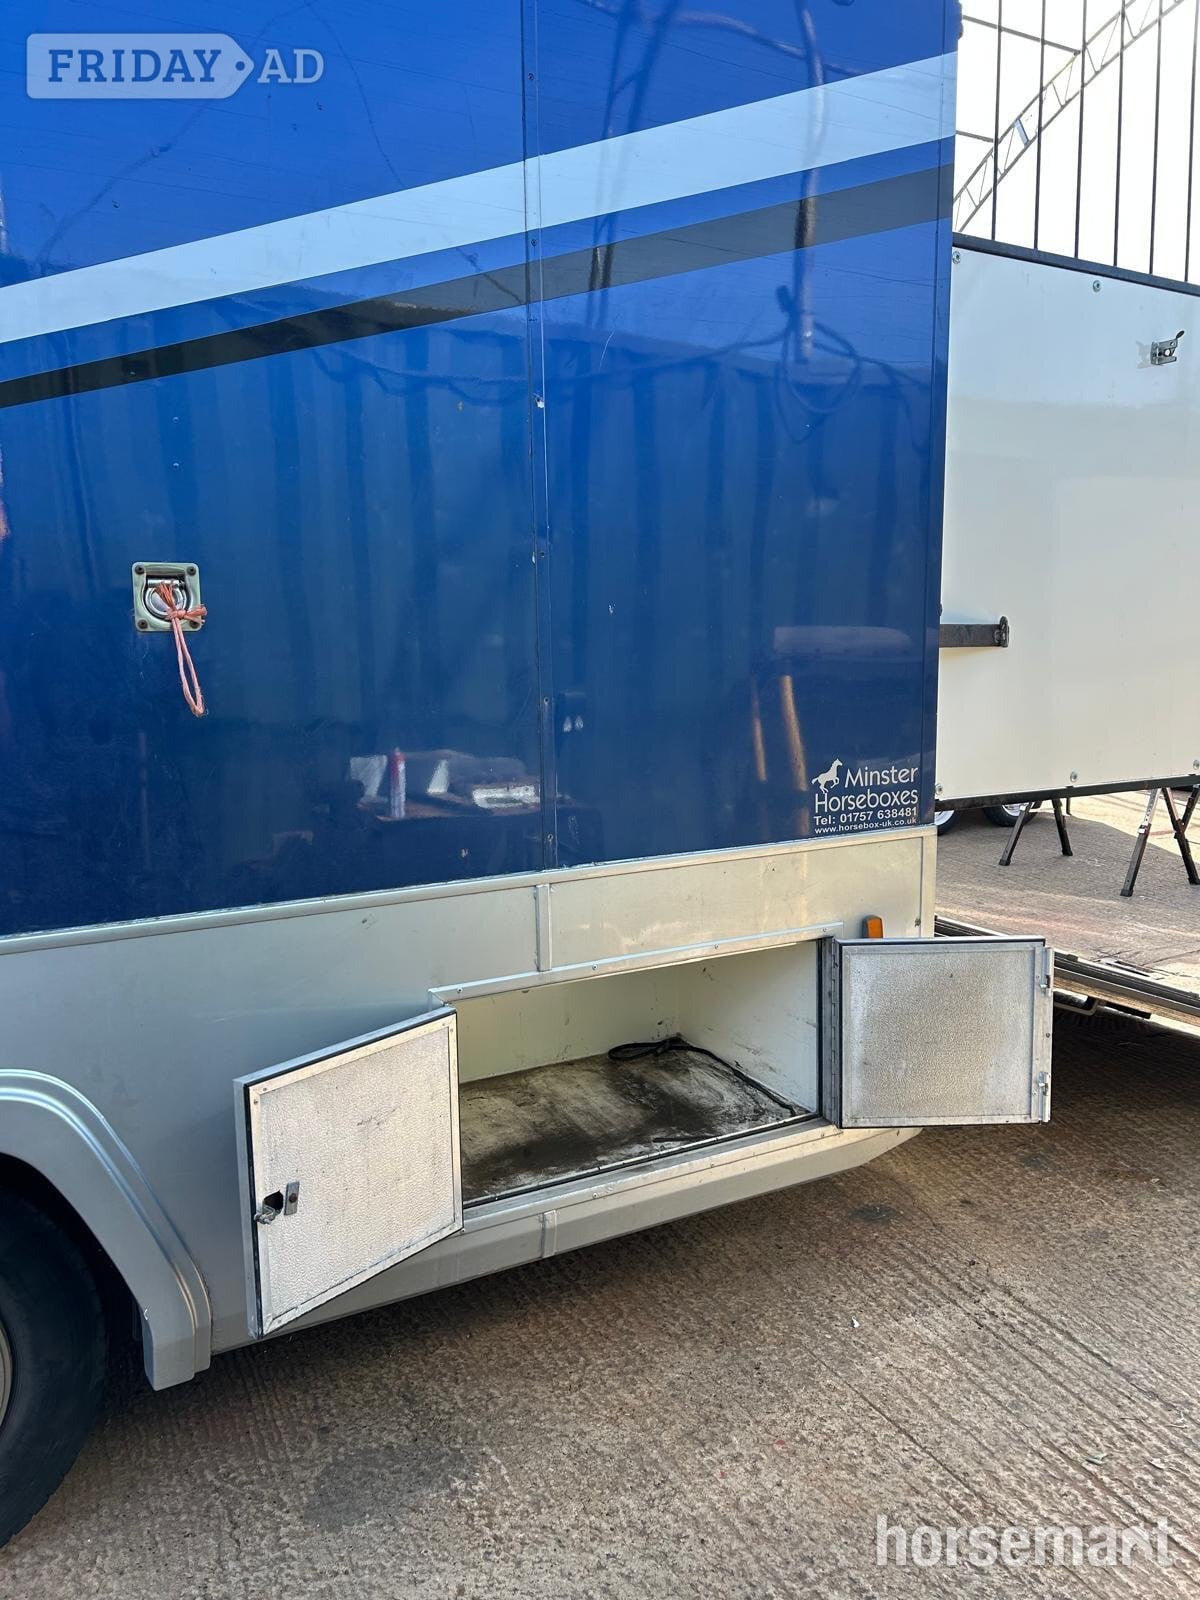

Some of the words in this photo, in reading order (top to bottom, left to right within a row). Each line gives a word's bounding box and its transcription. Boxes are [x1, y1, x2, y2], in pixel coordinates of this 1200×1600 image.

[844, 766, 918, 788] Minster
[815, 788, 919, 813] Horseboxes
[813, 815, 836, 826] Tel:
[840, 811, 874, 823] 01757
[877, 807, 918, 820] 638481
[814, 817, 918, 834] www.horsebox-uk.co.uk
